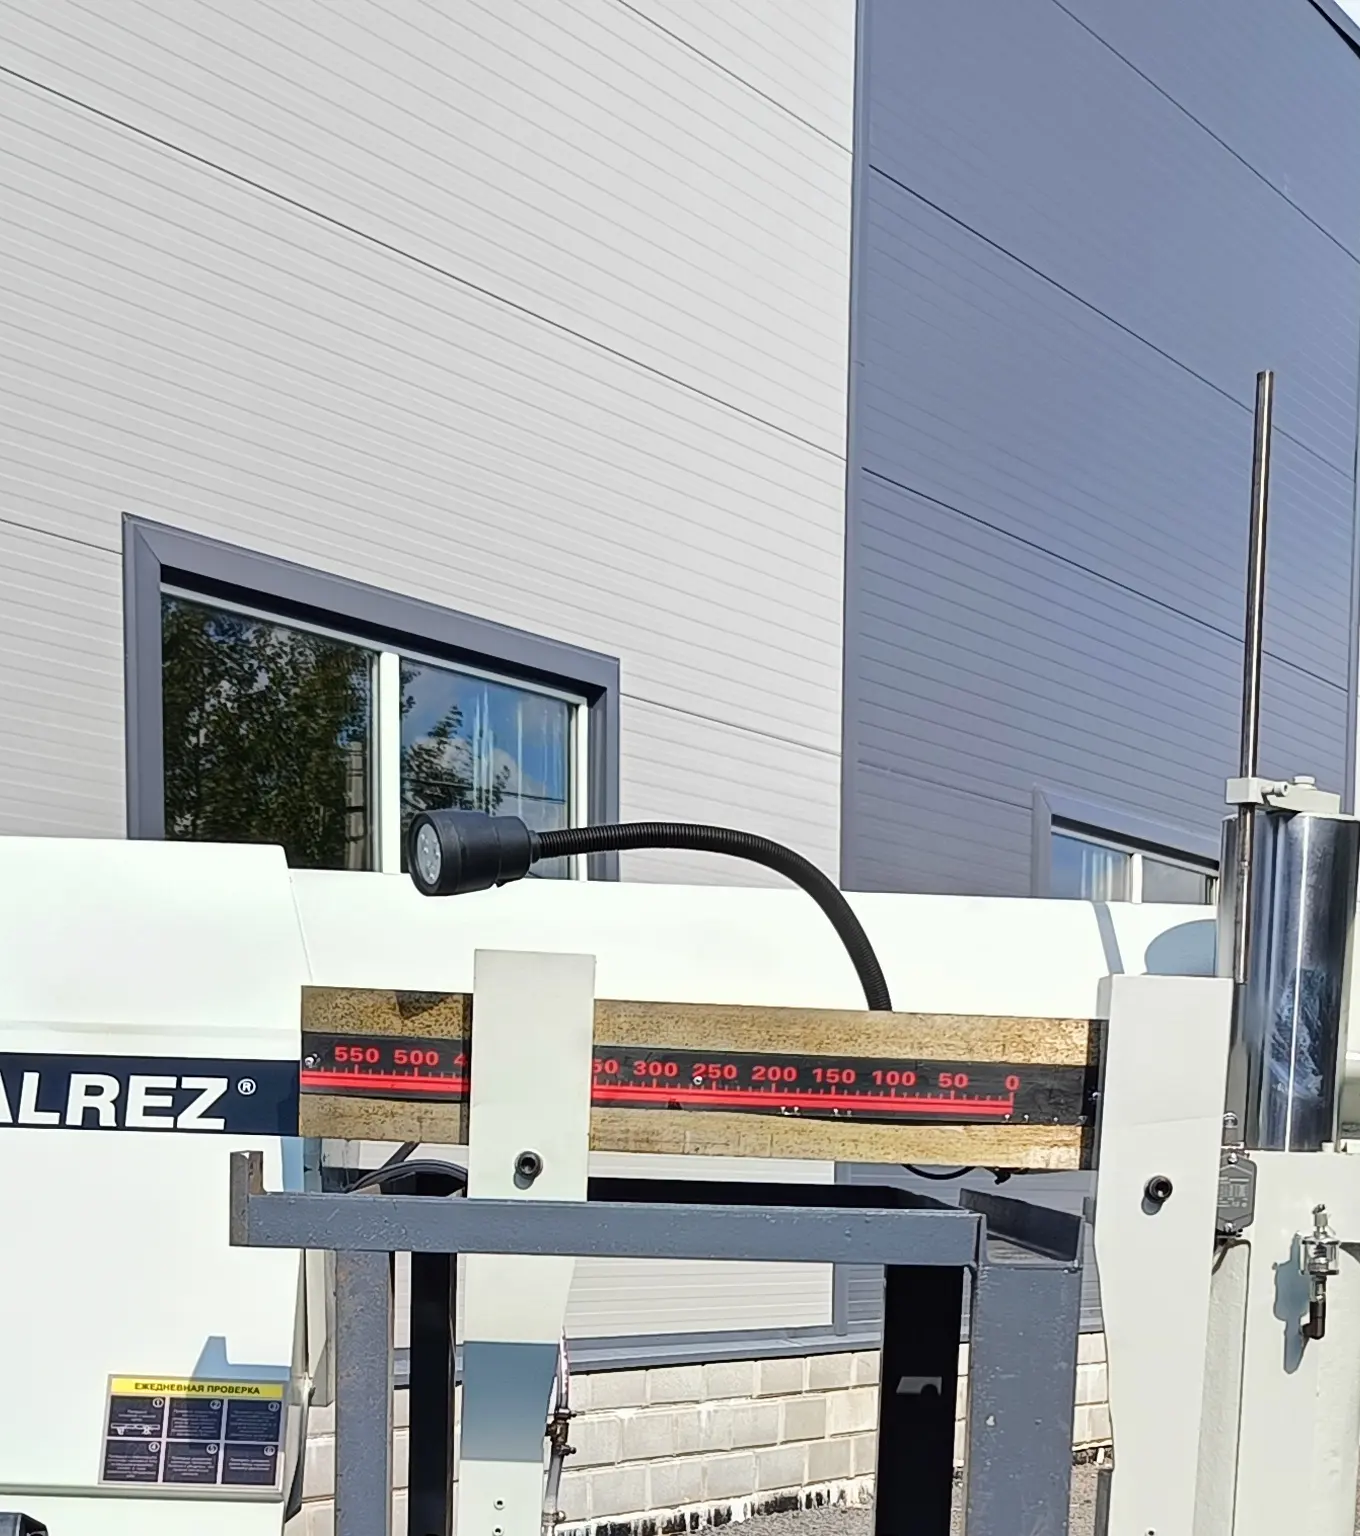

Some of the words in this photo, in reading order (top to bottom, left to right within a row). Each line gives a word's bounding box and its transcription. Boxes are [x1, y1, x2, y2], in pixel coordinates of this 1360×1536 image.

[334, 1046, 379, 1063] 550
[394, 1049, 439, 1066] 500
[592, 1058, 619, 1075] 50
[633, 1060, 678, 1077] 300
[692, 1063, 737, 1080] 250
[752, 1065, 797, 1082] 200
[812, 1067, 856, 1085] 150
[872, 1070, 916, 1087] 100
[939, 1072, 969, 1089] 50
[1005, 1074, 1020, 1091] 0
[134, 1382, 205, 1393] ЕЖЕДНЕВНАЯ
[207, 1384, 260, 1395] ПРОВЕРКА
